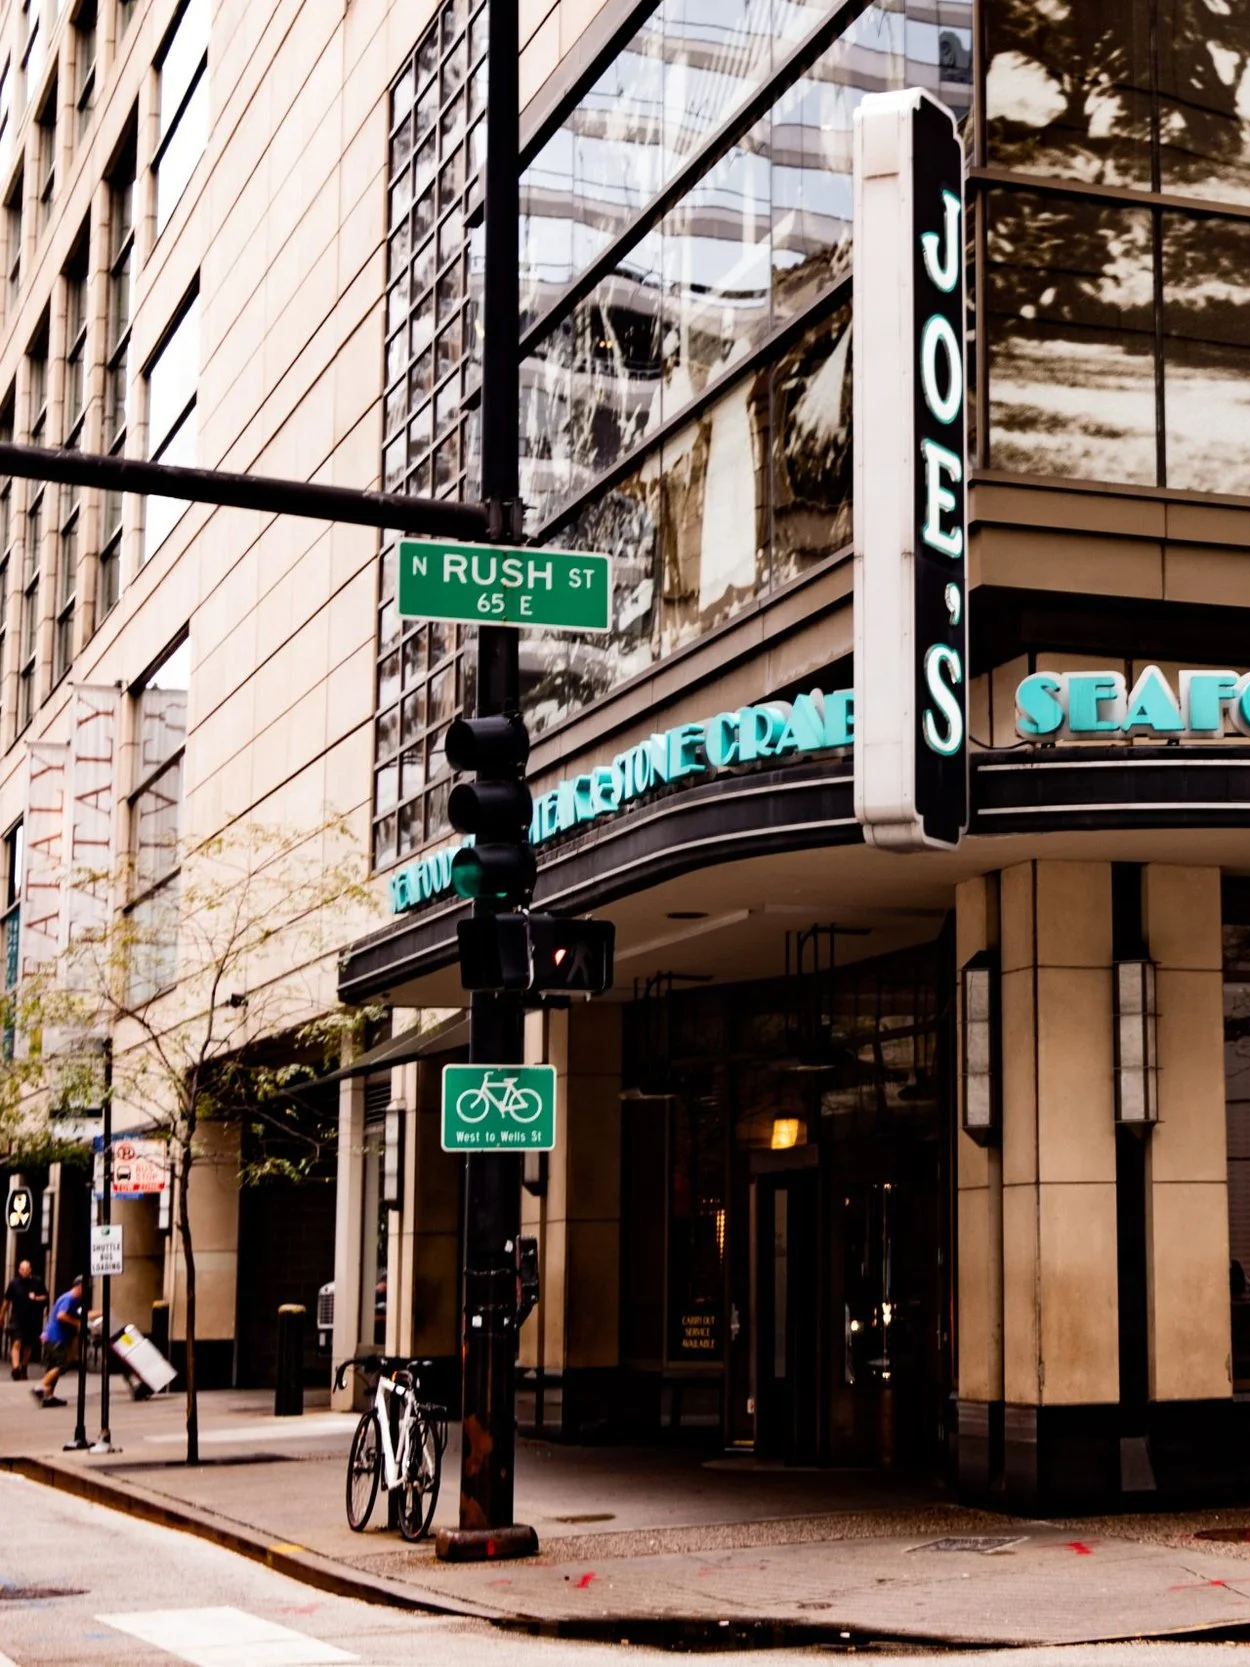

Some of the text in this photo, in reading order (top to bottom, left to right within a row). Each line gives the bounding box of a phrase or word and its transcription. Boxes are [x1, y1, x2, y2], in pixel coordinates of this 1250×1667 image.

[921, 188, 964, 757] JOE'S
[412, 553, 595, 590] N RUSH ST
[477, 592, 533, 616] 65 E
[611, 722, 706, 803] STONE
[456, 1130, 542, 1143] West to Wells St
